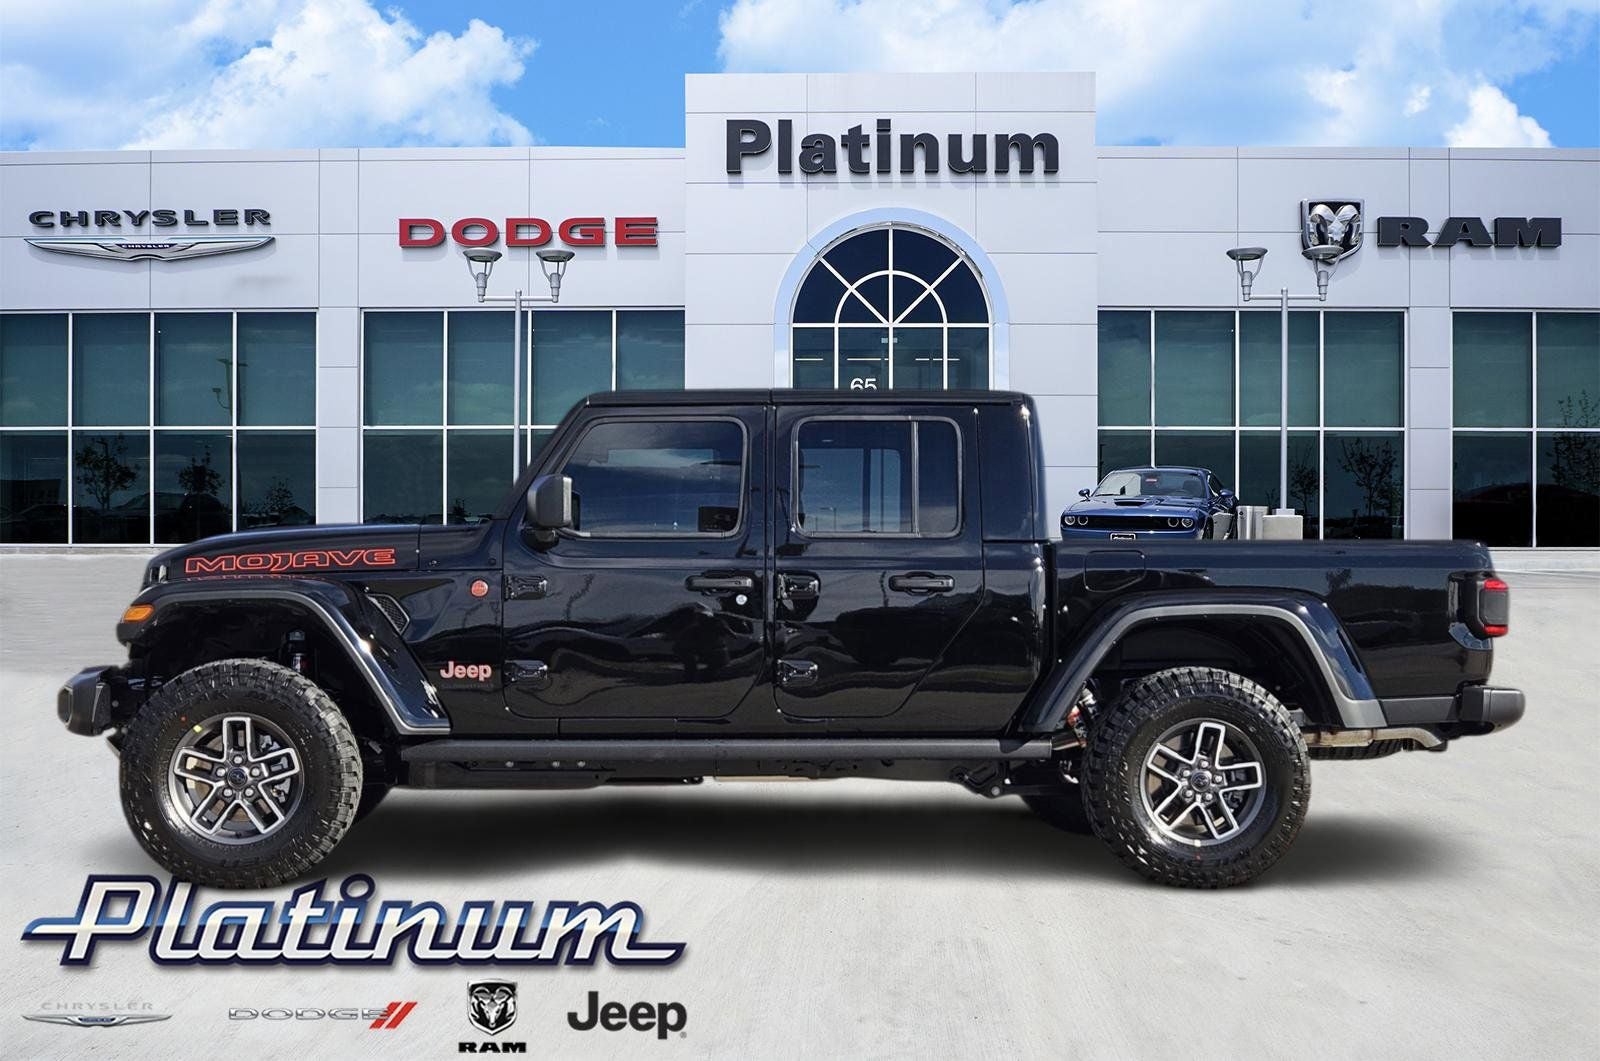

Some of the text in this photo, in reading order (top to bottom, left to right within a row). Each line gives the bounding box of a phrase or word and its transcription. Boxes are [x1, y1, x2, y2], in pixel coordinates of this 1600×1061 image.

[726, 118, 1060, 175] Platinum
[28, 207, 272, 228] CHRYSLER
[1377, 216, 1562, 248] RAM
[399, 217, 659, 249] DODGE
[185, 548, 395, 574] MOJAVE
[440, 660, 492, 682] Jeep
